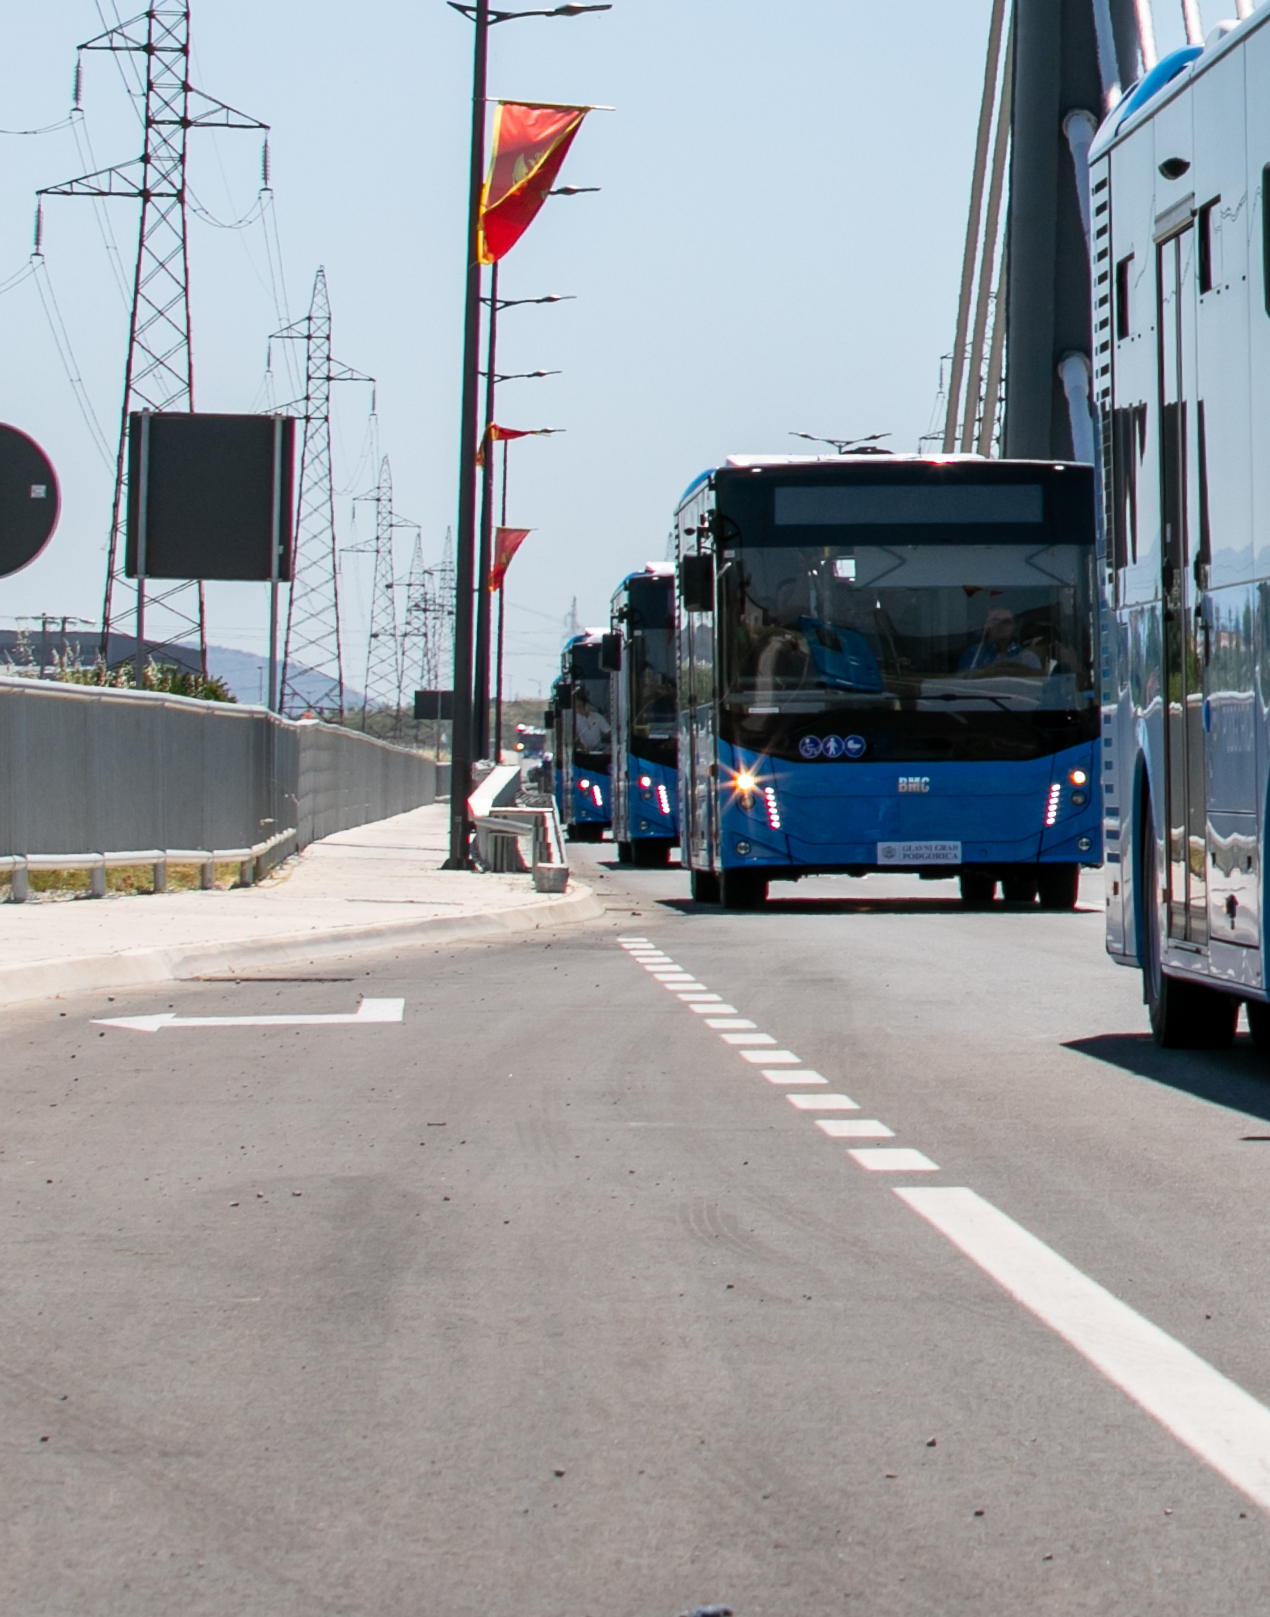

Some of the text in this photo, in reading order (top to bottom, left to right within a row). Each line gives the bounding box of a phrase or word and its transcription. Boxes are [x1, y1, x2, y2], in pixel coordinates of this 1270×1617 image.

[898, 776, 930, 793] BMC
[902, 844, 933, 852] GLAVNI
[902, 852, 958, 860] PODGORICA
